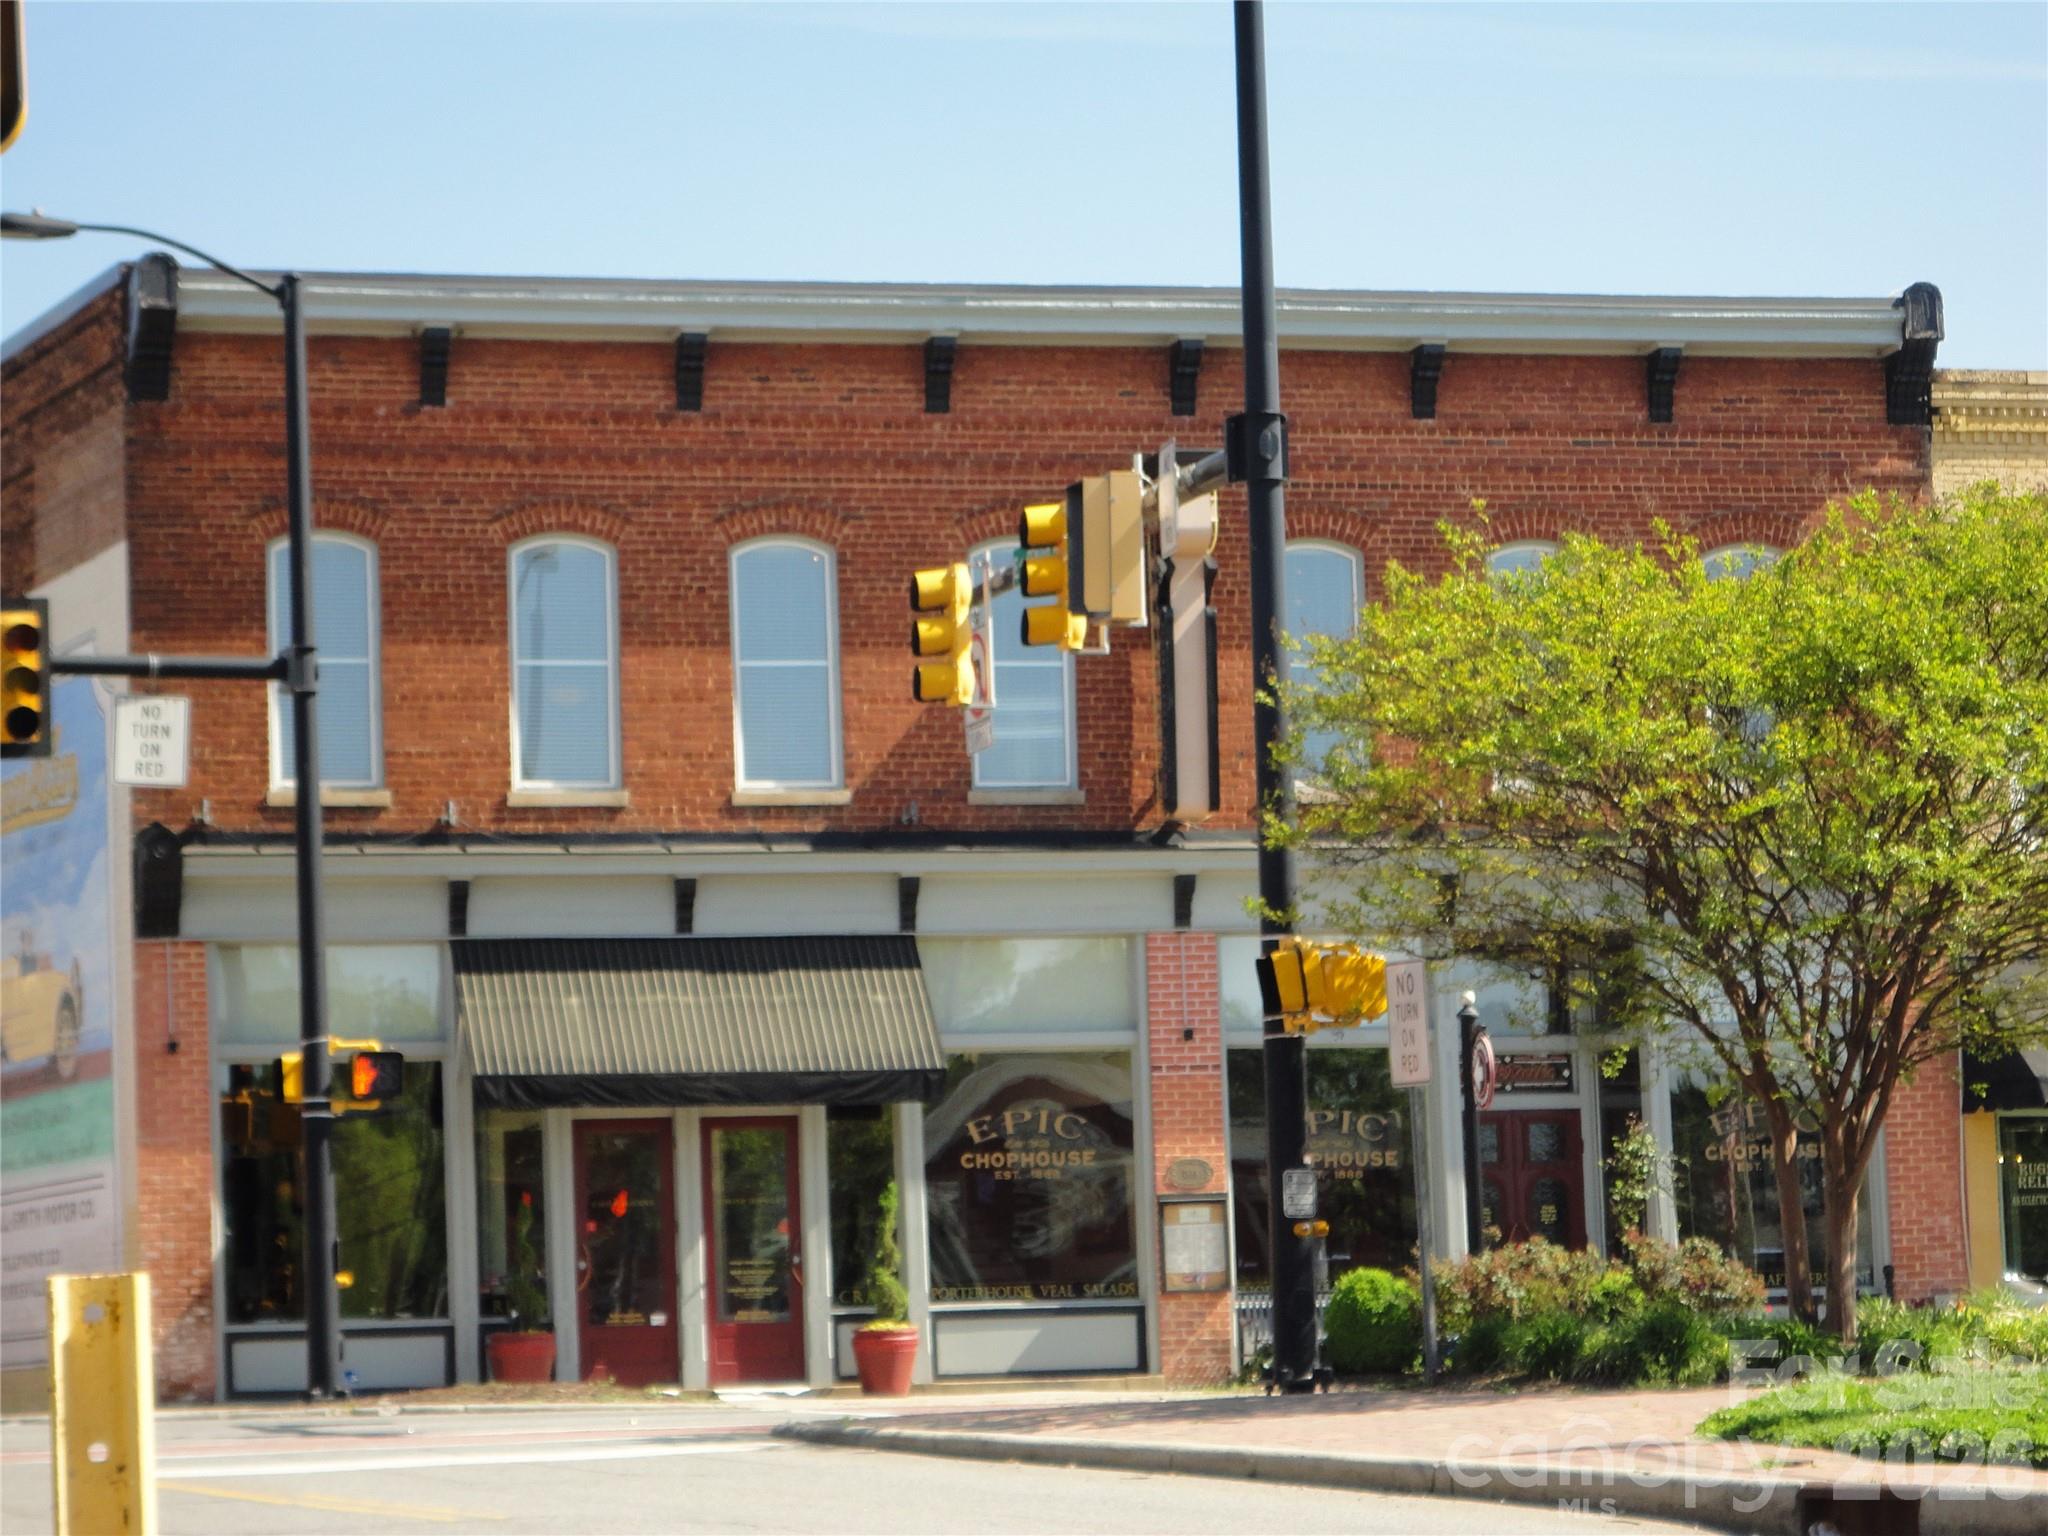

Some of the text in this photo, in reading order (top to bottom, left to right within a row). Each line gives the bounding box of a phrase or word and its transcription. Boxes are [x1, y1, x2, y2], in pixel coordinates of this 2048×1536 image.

[141, 705, 161, 720] NO
[132, 723, 171, 738] TURN
[139, 742, 161, 758] ON
[134, 761, 165, 777] RED
[1396, 973, 1415, 996] NO
[1395, 1002, 1419, 1023] TURN
[1401, 1028, 1416, 1048] ON
[1401, 1055, 1419, 1075] RED
[965, 1109, 1088, 1145] EPIC
[1304, 1109, 1388, 1142] PIC
[960, 1150, 1096, 1169] CHOPHOUSE
[1309, 1150, 1399, 1169] PHOUSE
[931, 1283, 1136, 1300] PORTERHOUSE VEAL SALADS
